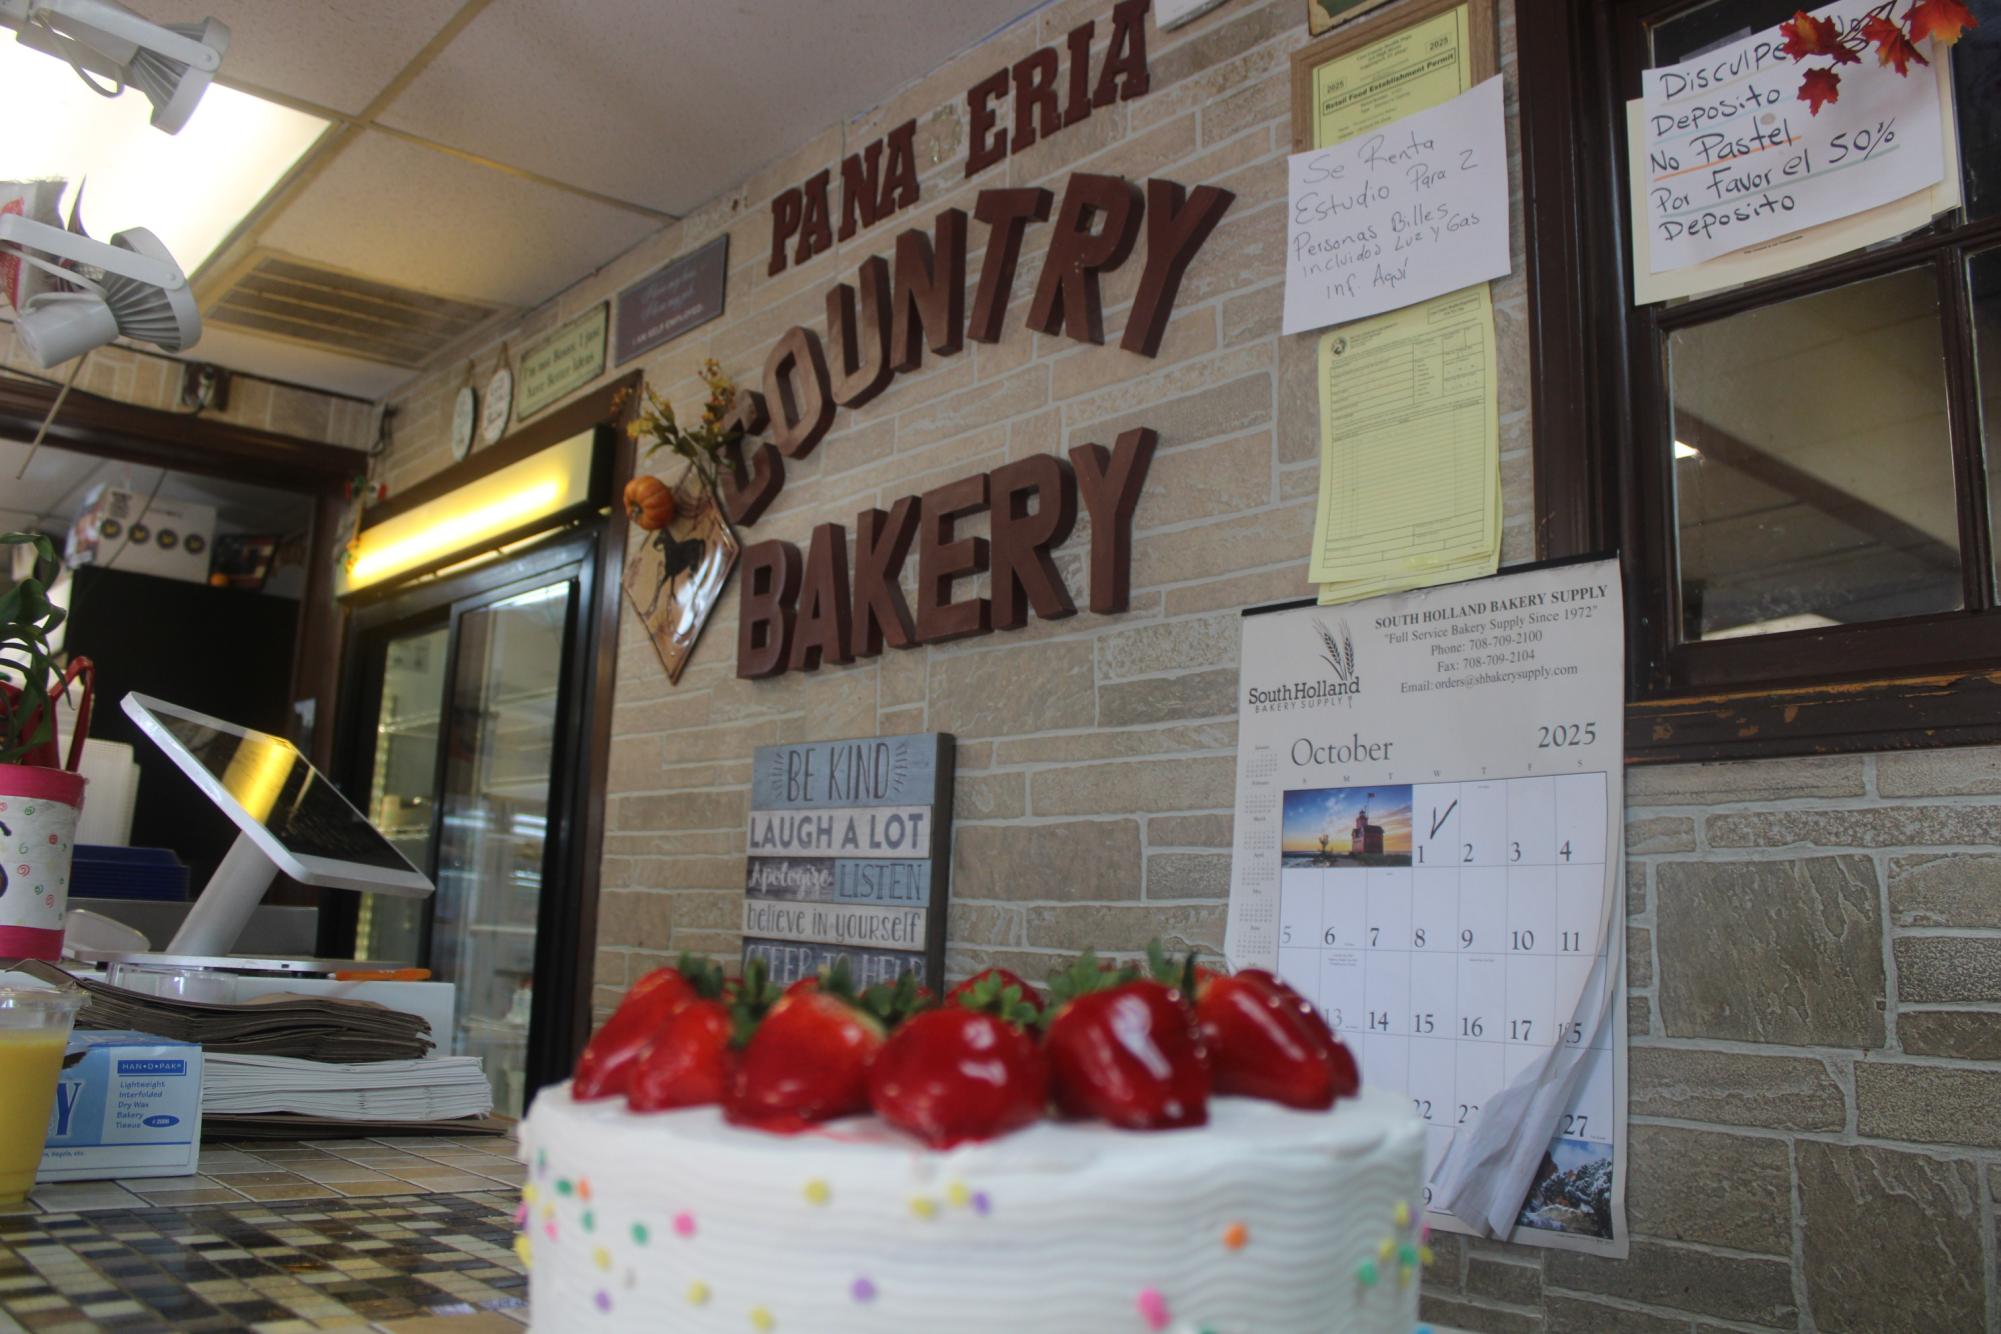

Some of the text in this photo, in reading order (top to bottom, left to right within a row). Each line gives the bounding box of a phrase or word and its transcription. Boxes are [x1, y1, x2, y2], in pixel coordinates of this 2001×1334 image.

[1429, 36, 1449, 51] 2025
[1325, 97, 1347, 111] Retail
[1349, 89, 1368, 102] Food
[1369, 65, 1425, 93] Establishment
[1427, 53, 1454, 71] Permit
[1651, 84, 1780, 136] Deposito
[768, 0, 1151, 277] PANA ERIA
[1650, 116, 1792, 174] No Pastel
[1303, 131, 1434, 184] Se Renta
[1651, 118, 1896, 213] Por Favor el 50%
[1295, 149, 1478, 224] Estudio Para 2
[1293, 203, 1449, 261] Personas Billes
[1394, 232, 1423, 251] Luz
[1446, 213, 1480, 232] Gas
[1659, 193, 1795, 241] Deposito
[717, 172, 1236, 528] COUNTRY
[736, 426, 1158, 679] BAKERY
[1375, 585, 1608, 629] SOUTH HOLLAND BAKERY SUPPLY
[1411, 628, 1449, 642] Service
[1451, 621, 1486, 637] Bakery
[1490, 614, 1525, 632] Supply
[1528, 609, 1560, 624] Since
[1431, 629, 1543, 656] Phone: 708-709-2100
[1437, 649, 1536, 673] Fax: 708-709-2104
[1249, 676, 1360, 705] South Holland
[1400, 680, 1434, 694] Email:
[1255, 697, 1343, 713] BAKERY SUPPLY
[1291, 733, 1394, 766] October
[1538, 721, 1596, 748] 2025
[787, 742, 890, 802] BE KIND
[750, 813, 923, 850] LAUGH A LOT
[1417, 840, 1572, 864] 1 2 3 4
[838, 863, 923, 900] LISTEN
[747, 903, 806, 934] believe
[1281, 925, 1581, 952] 5 6 7 8 9 10 11
[1368, 1011, 1389, 1032] 14
[1414, 1013, 1435, 1033] 15
[1461, 1017, 1483, 1037] 16
[1510, 1020, 1533, 1041] 17
[119, 1090, 163, 1099] Interfolded
[120, 1081, 165, 1090] Lightweight
[116, 1111, 144, 1120] Bakery
[118, 1101, 149, 1110] Dry Wax
[116, 1121, 142, 1129] Tissue
[1563, 1114, 1588, 1137] 27
